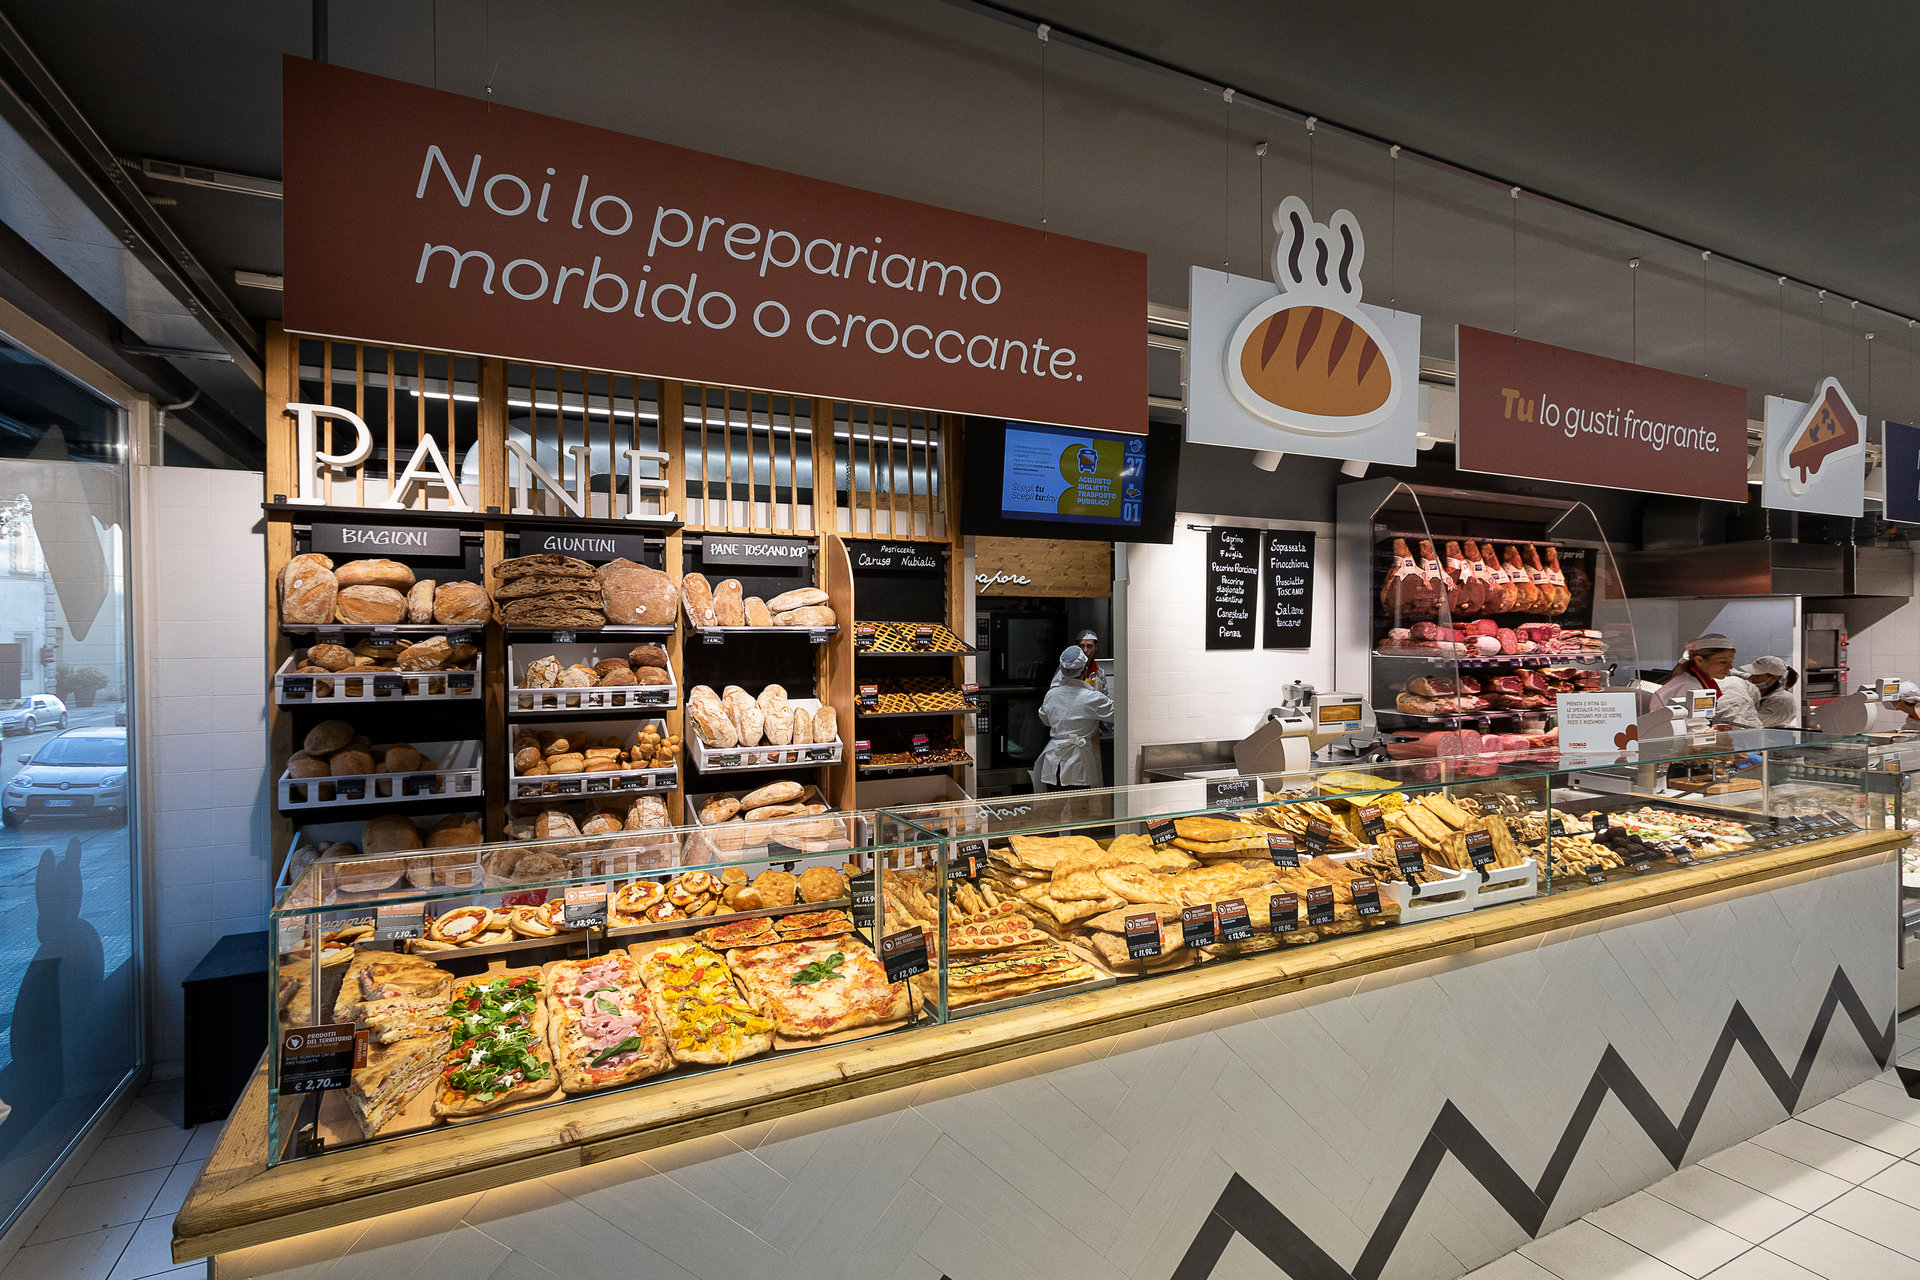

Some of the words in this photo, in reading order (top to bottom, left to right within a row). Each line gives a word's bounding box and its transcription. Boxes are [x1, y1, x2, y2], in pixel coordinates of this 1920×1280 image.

[416, 145, 555, 223] Noi
[571, 175, 633, 236] lo
[648, 206, 1001, 305] prepariamo
[416, 242, 736, 329] morbido
[753, 300, 790, 337] o
[806, 309, 1083, 382] croccante.
[1501, 387, 1534, 423] Tu
[1539, 393, 1560, 427] lo
[1564, 407, 1621, 438] gusti
[1624, 409, 1719, 452] fragrante.
[286, 402, 676, 521] PANE
[1078, 476, 1111, 485] ACQUISTO
[1012, 483, 1034, 493] Scegli
[1035, 485, 1044, 493] tu
[1078, 484, 1109, 492] BIGLIETTI
[1012, 491, 1034, 501] Scegli
[1035, 493, 1057, 503] tuday
[1077, 491, 1116, 500] TRASPORTO
[1077, 498, 1109, 506] PUBBLICO
[1123, 503, 1139, 521] 01
[342, 527, 429, 546] BIAGIONI
[1221, 531, 1244, 543] Caprino
[544, 536, 616, 553] GIUNTINI
[710, 543, 739, 556] PANE
[743, 544, 788, 556] TOSCANO
[790, 546, 806, 557] DOP
[858, 553, 891, 566] Caruso
[901, 555, 936, 567] Nubialis
[1211, 562, 1235, 572] Pecorino
[1275, 602, 1304, 616] Salame
[1219, 626, 1241, 638] Pienza
[899, 966, 917, 979] 12,90
[294, 1083, 302, 1091] €
[305, 1078, 331, 1090] 2,70
